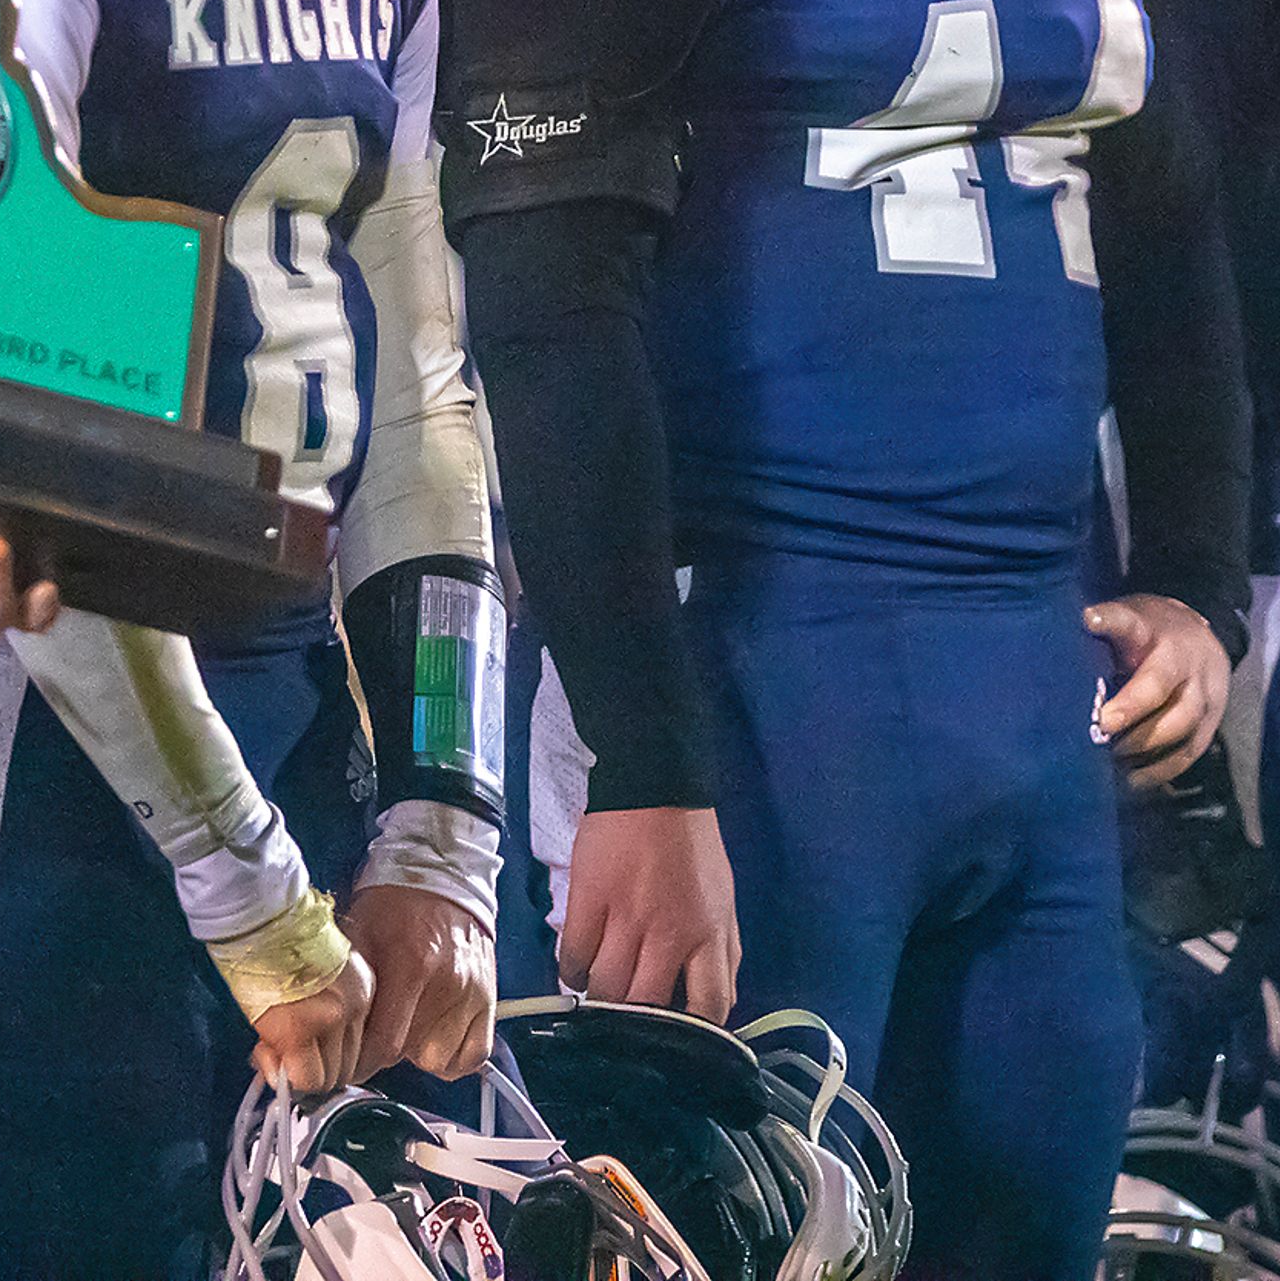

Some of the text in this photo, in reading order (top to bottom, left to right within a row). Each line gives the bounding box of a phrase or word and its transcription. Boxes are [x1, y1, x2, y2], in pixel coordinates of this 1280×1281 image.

[494, 114, 582, 143] Douglas
[224, 116, 360, 512] 8
[57, 347, 164, 397] PLACE
